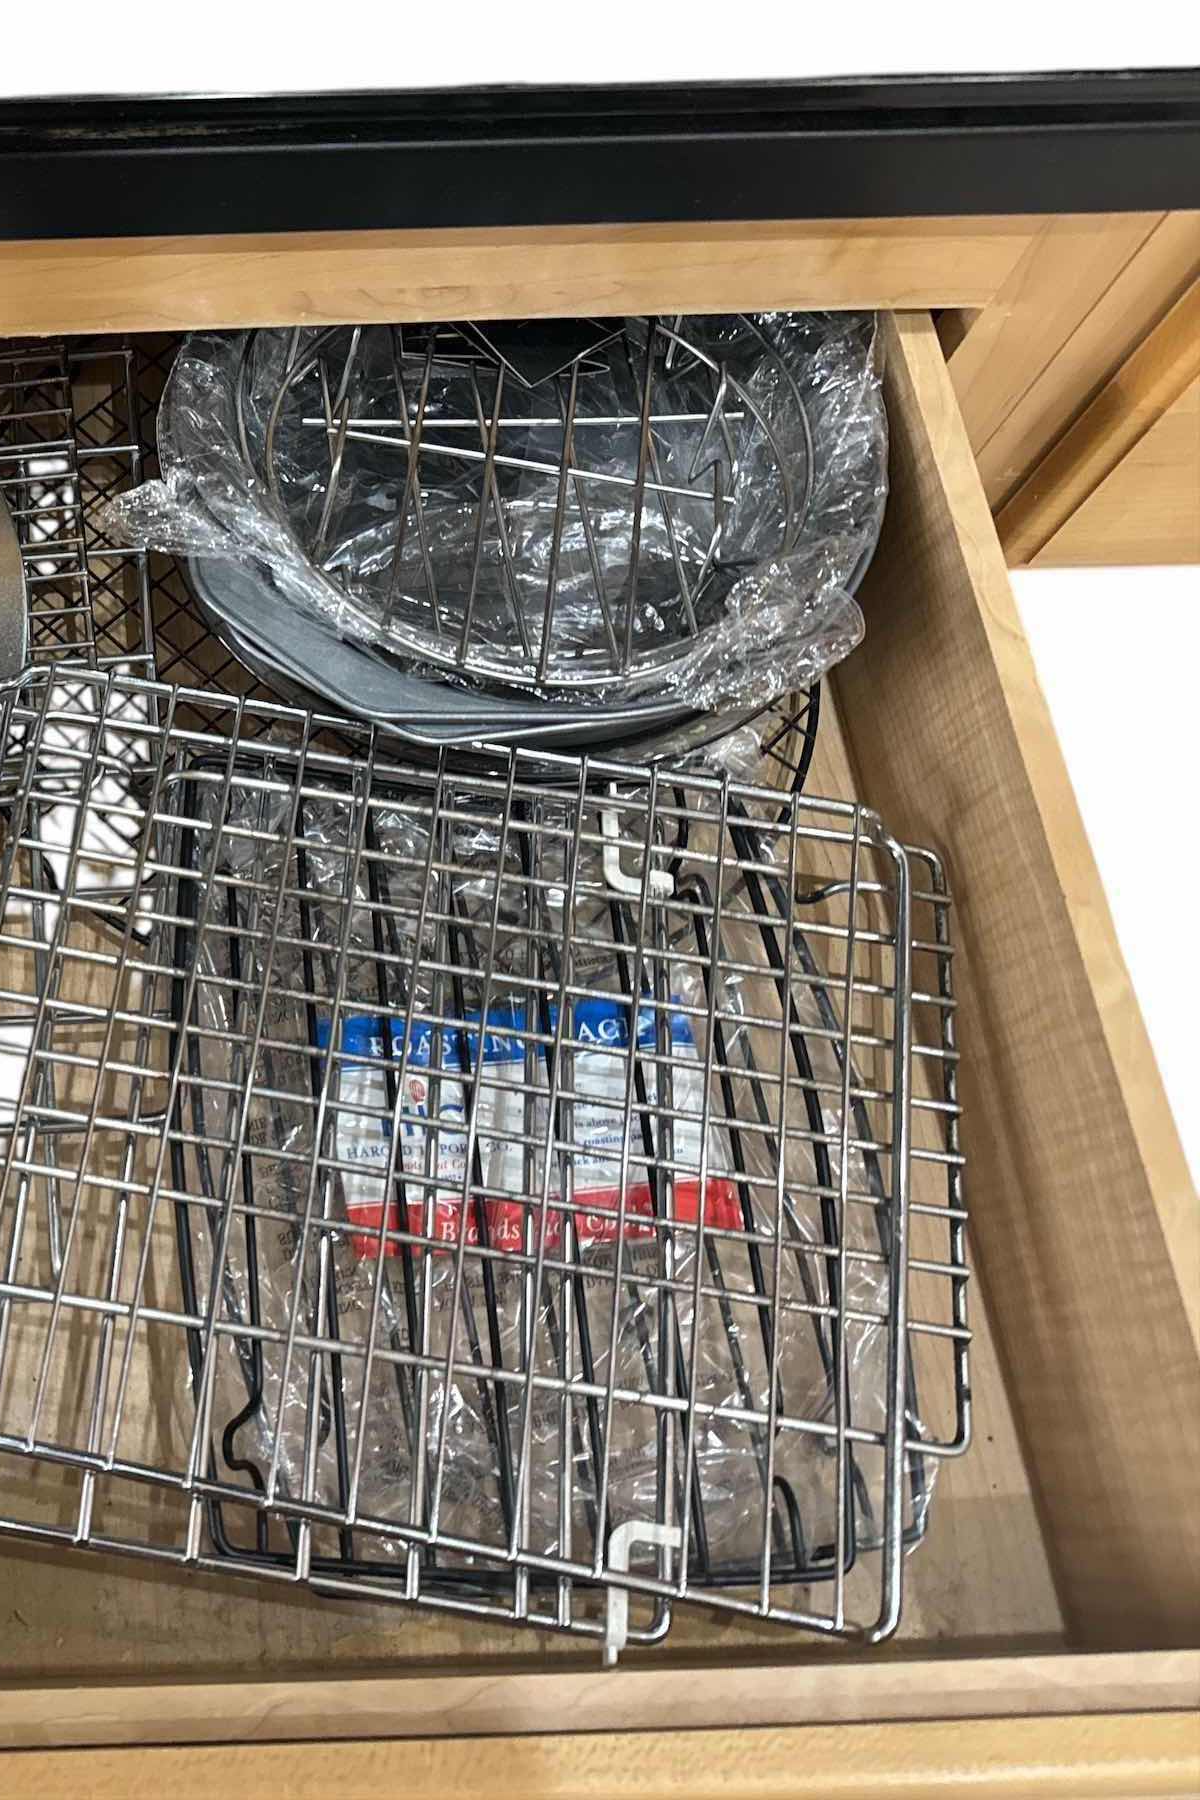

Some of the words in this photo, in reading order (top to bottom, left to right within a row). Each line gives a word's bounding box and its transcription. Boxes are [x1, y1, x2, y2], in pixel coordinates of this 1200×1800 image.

[369, 1033, 526, 1057] ROASN
[347, 1143, 412, 1159] HAROD
[583, 1136, 625, 1148] roastin
[441, 1217, 520, 1242] Bands
